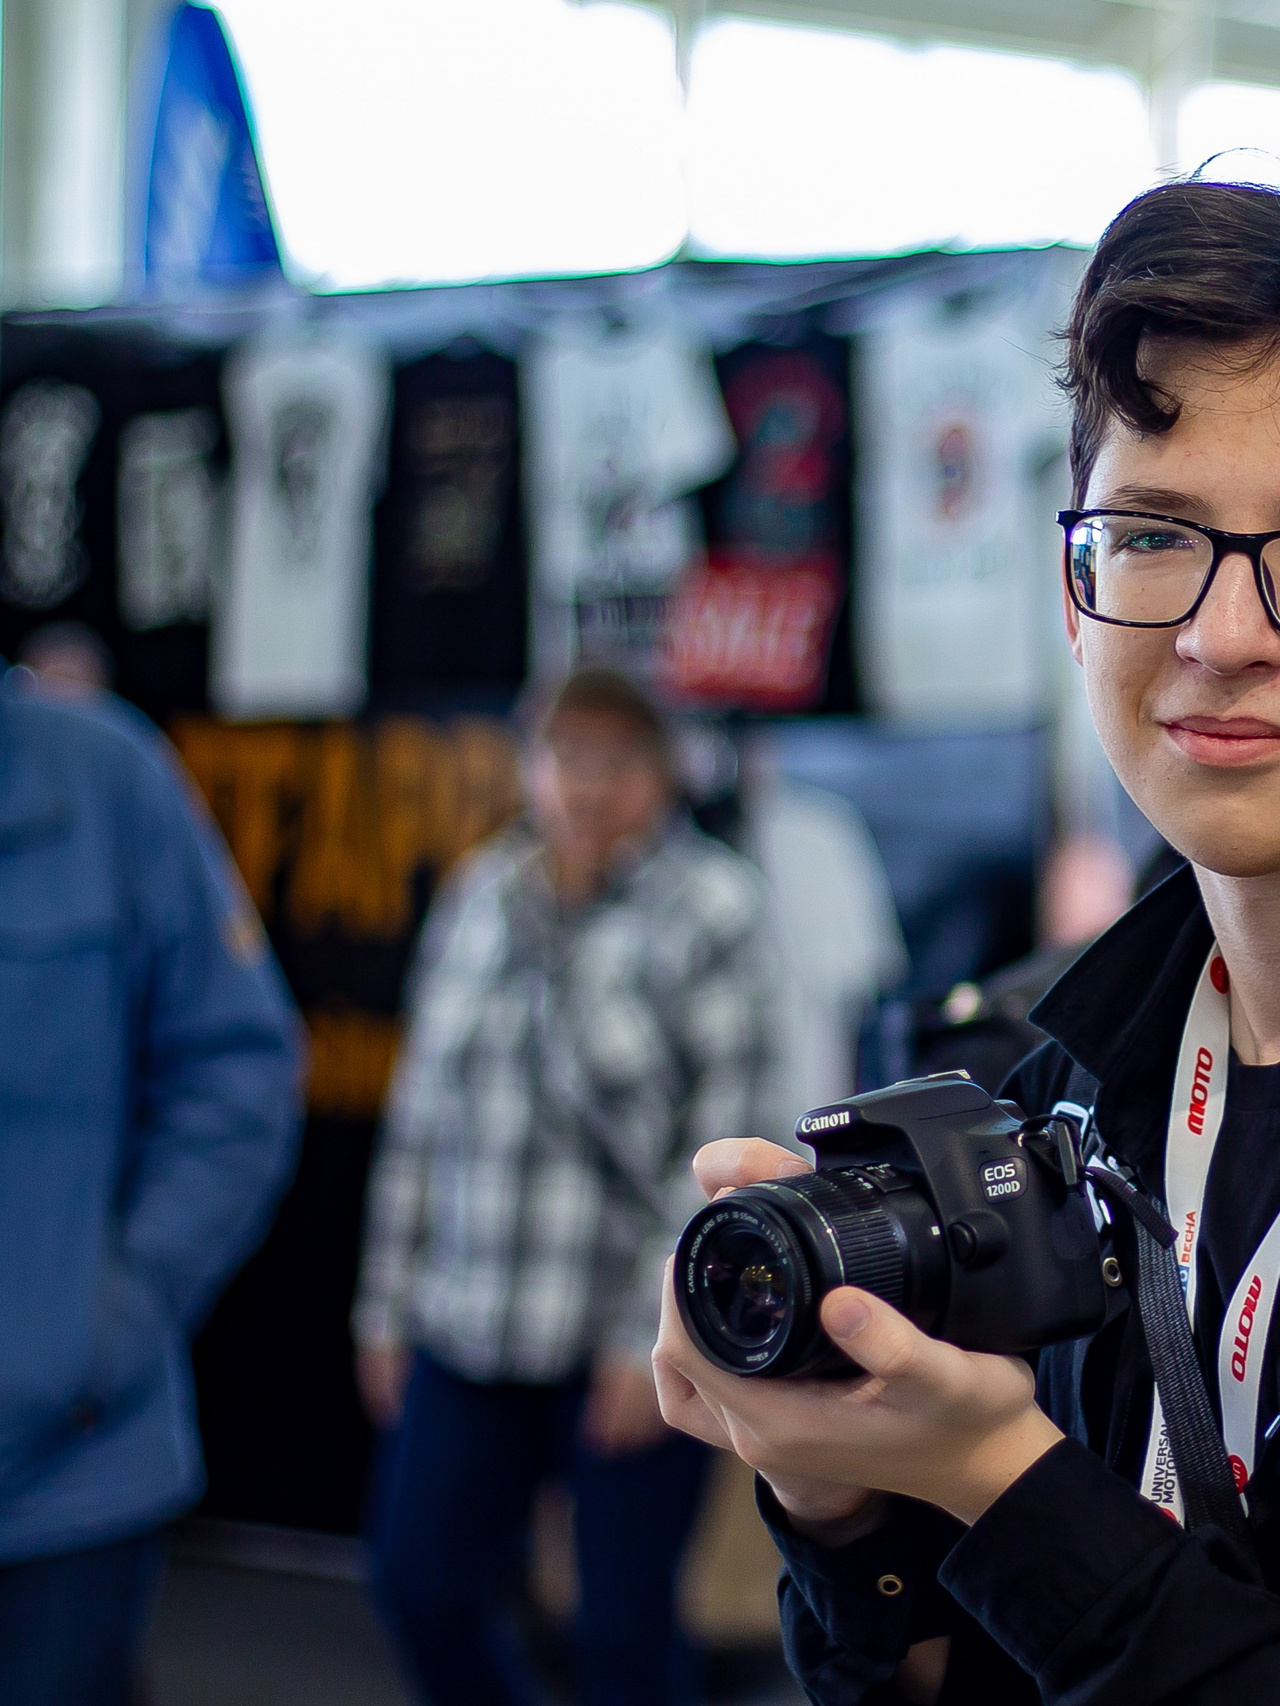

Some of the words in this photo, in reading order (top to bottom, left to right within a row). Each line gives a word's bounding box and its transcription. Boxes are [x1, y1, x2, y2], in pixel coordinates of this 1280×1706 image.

[1187, 1047, 1213, 1135] MOTO
[801, 1111, 850, 1133] Canon
[984, 1163, 1016, 1182] EOS
[986, 1181, 1021, 1197] 1200D
[690, 1234, 703, 1259] ZOOM
[1180, 1210, 1197, 1264] ВЕСНА
[687, 1261, 695, 1294] CANON
[1231, 1274, 1262, 1383] MOTO
